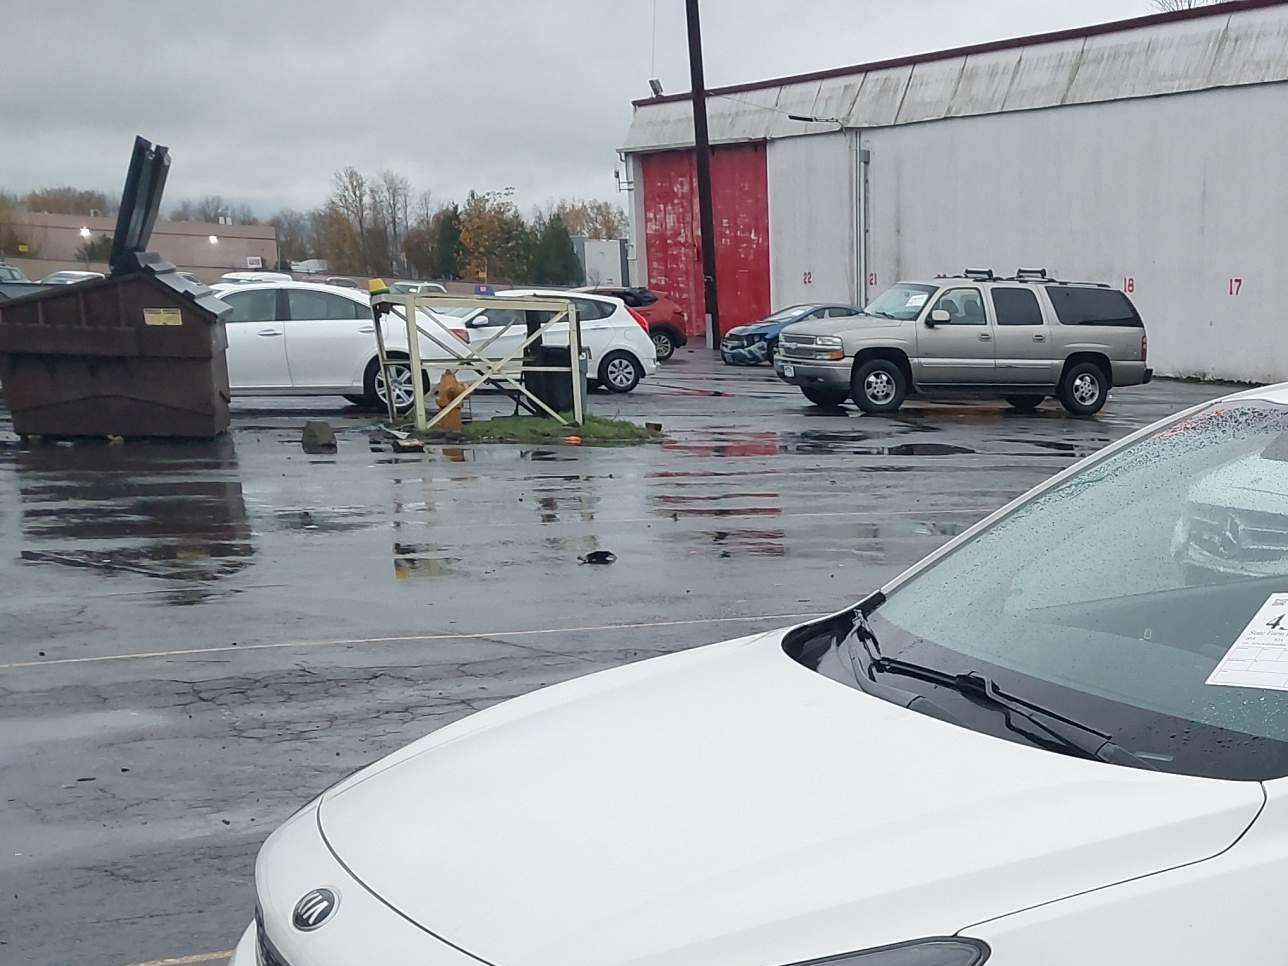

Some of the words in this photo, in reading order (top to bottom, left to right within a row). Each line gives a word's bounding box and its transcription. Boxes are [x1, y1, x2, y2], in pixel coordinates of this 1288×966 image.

[803, 272, 813, 285] 22
[869, 273, 878, 286] 21
[1123, 277, 1135, 293] 18
[1229, 280, 1242, 296] 17
